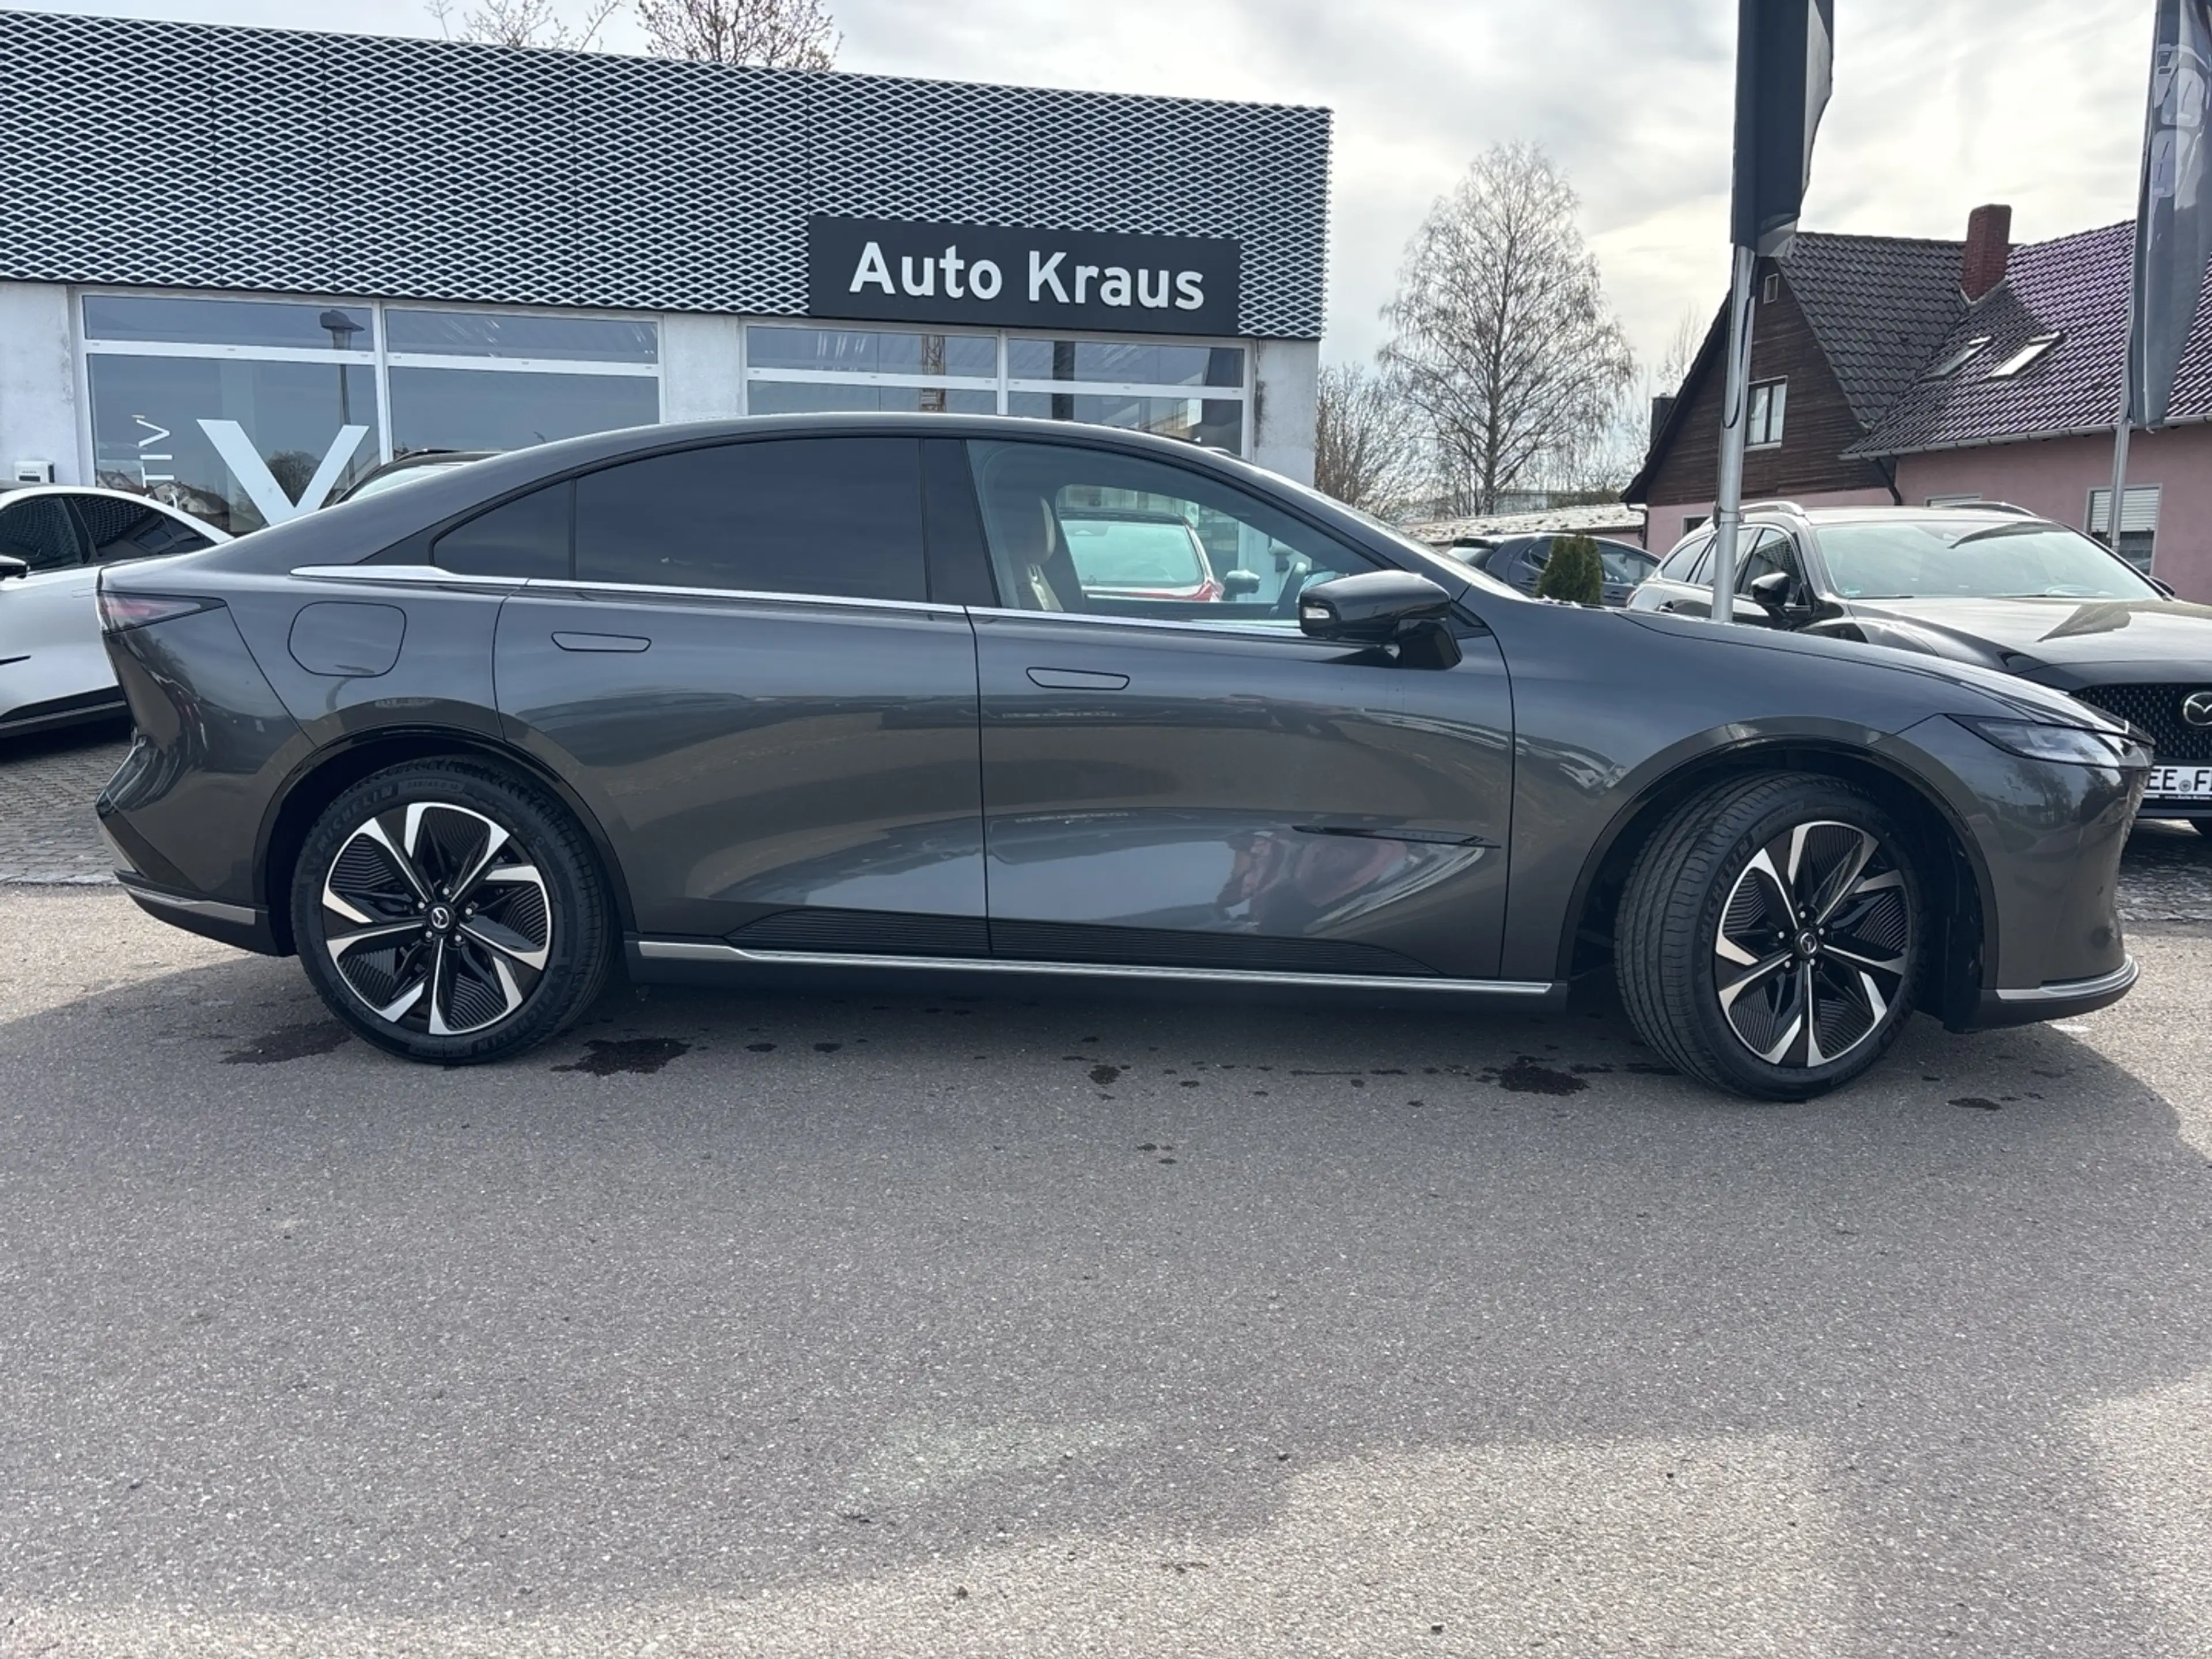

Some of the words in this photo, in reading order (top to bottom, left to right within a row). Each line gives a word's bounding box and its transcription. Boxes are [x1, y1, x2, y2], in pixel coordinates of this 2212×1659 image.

[849, 241, 1003, 301] Auto
[1028, 250, 1205, 312] Kraus
[2193, 769, 2212, 792] F
[317, 785, 393, 851] MICHELIN
[1700, 838, 1751, 945] MICHELIN
